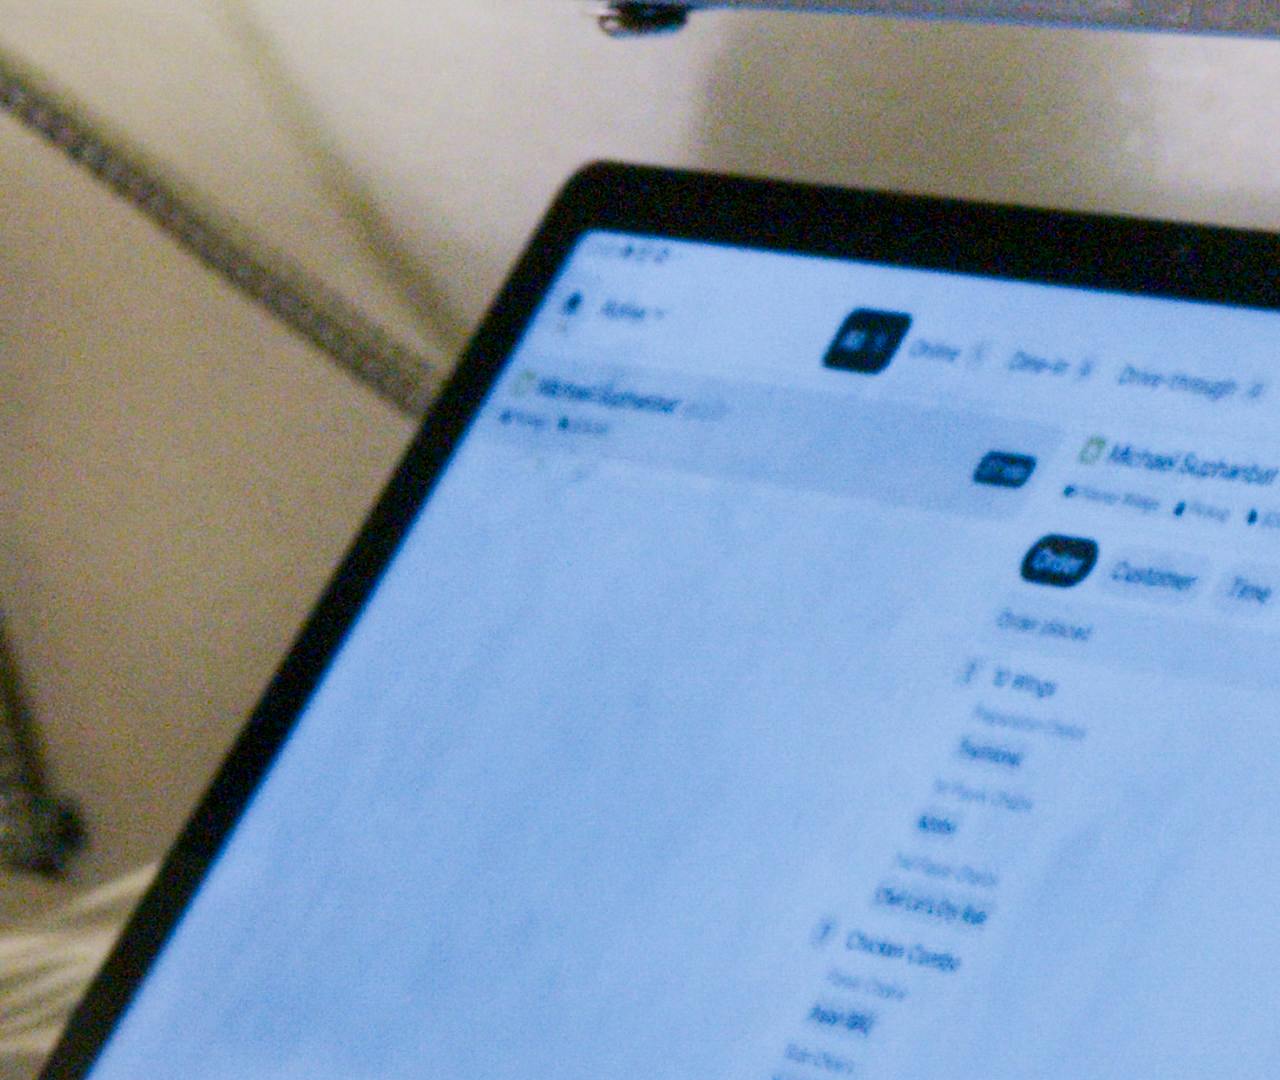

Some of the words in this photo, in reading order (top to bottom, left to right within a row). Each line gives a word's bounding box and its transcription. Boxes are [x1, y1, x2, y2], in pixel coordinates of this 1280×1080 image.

[1118, 363, 1239, 400] Drive-through
[1107, 443, 1177, 470] Michael
[1033, 550, 1080, 577] Order
[1111, 559, 1198, 592] Customer
[1232, 574, 1272, 605] Time
